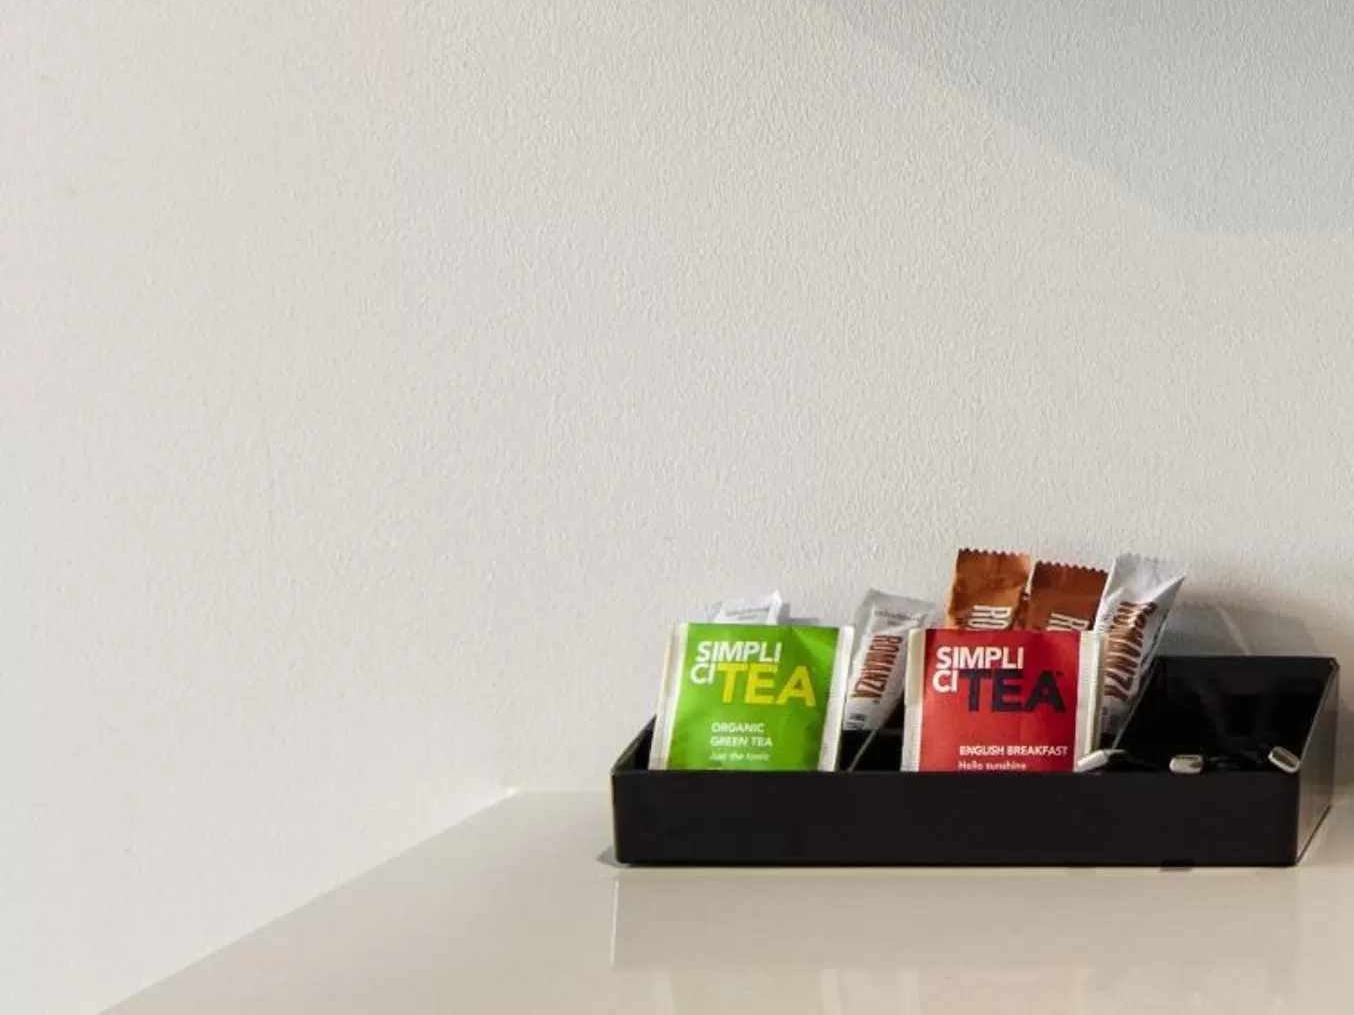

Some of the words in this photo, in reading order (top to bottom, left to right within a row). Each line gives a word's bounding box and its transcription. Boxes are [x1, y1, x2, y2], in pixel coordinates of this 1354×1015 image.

[696, 641, 782, 664] SIMPLI
[936, 646, 1024, 669] SIMPLI
[852, 635, 903, 699] ROMANZA
[711, 722, 764, 733] ORGANIC
[710, 737, 748, 748] GREEN
[751, 737, 773, 748] TEA
[959, 745, 1004, 756] ENGLISH
[1007, 745, 1068, 756] BREAKFAST
[958, 760, 983, 771] Hello
[986, 760, 1026, 771] sunshine
